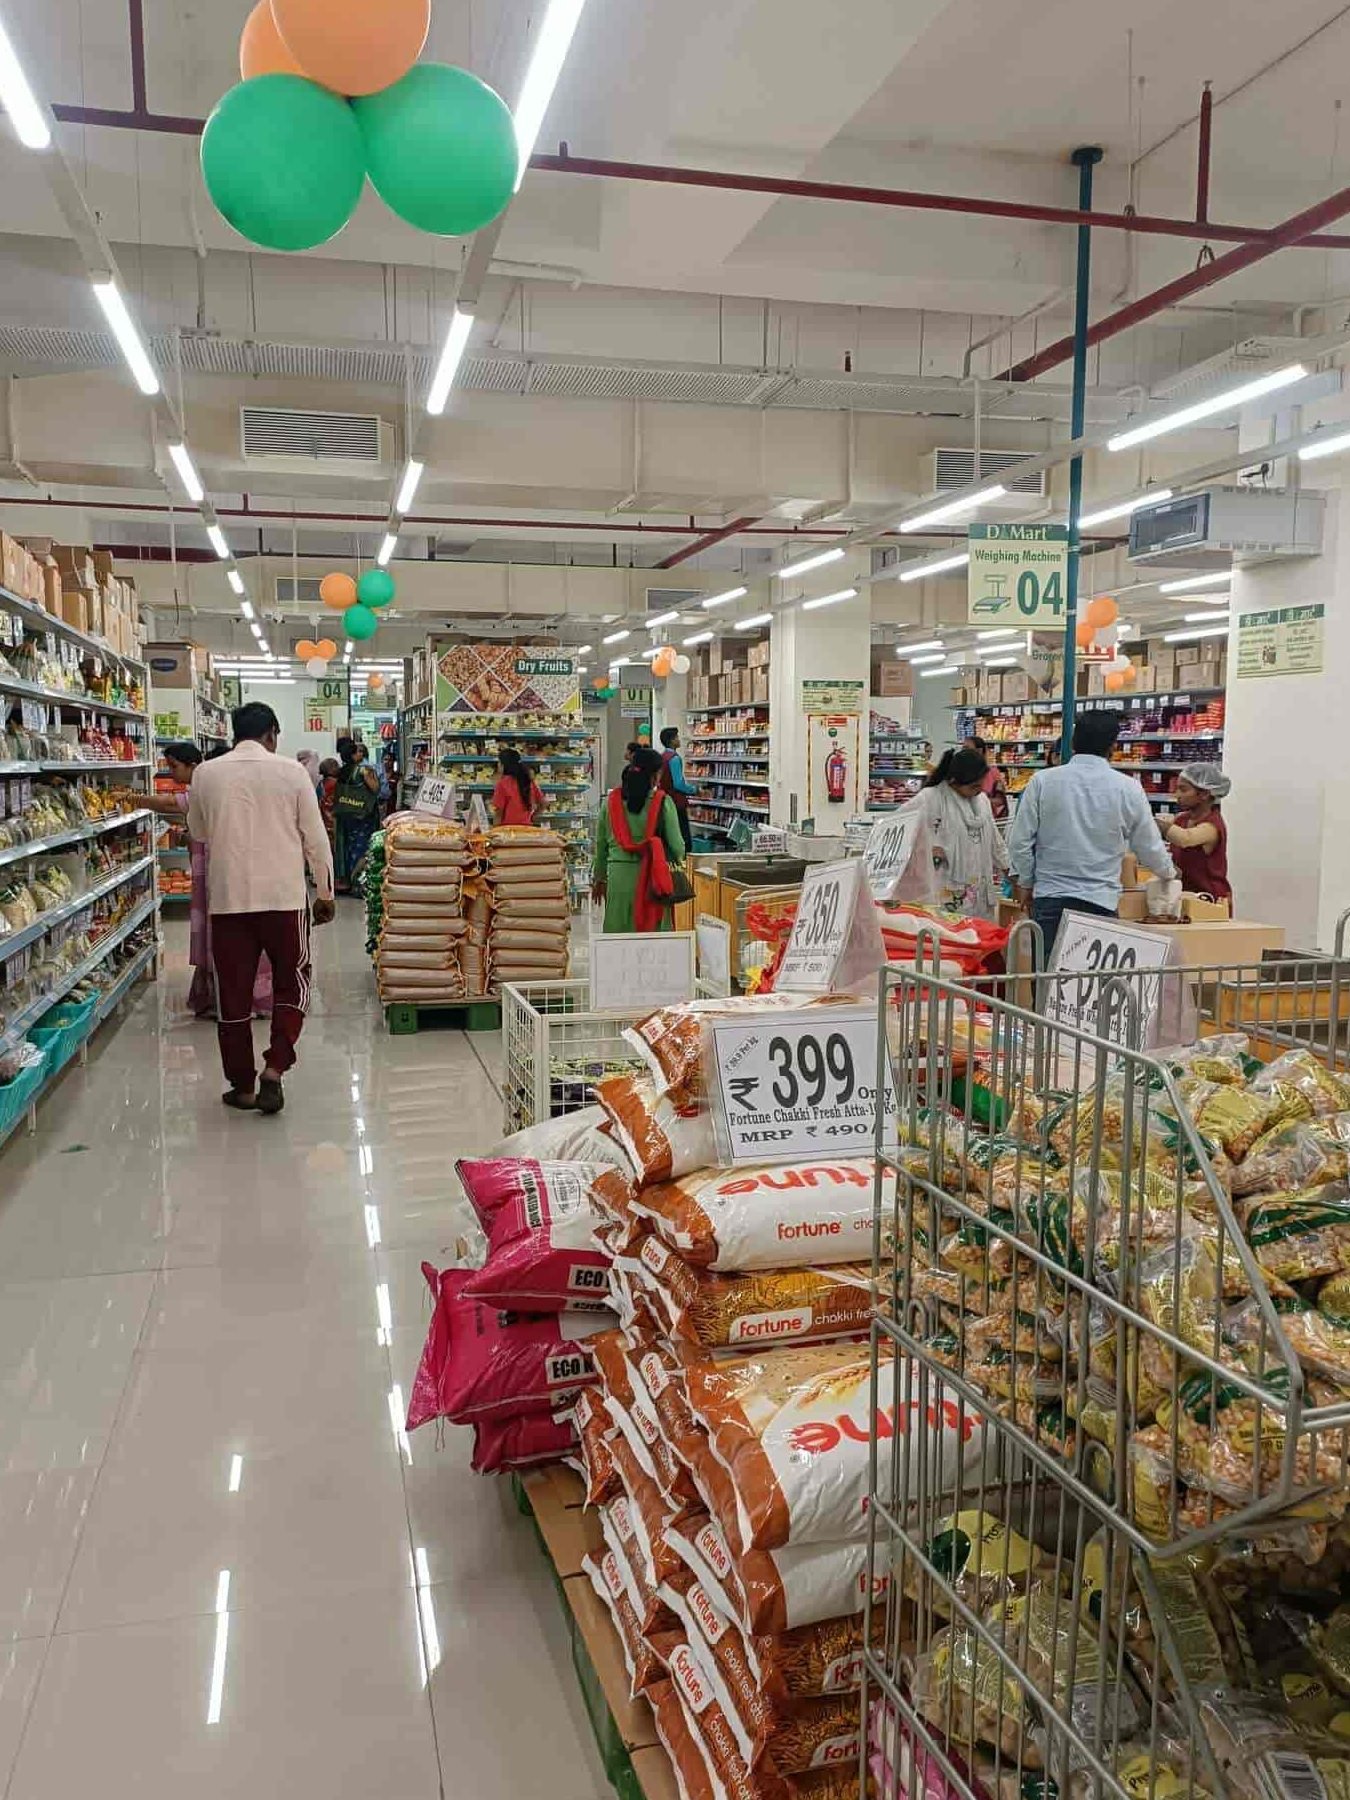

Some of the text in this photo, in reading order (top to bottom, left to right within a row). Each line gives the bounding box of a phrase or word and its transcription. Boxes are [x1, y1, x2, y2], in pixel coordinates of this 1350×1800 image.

[975, 550, 1061, 564] Weighing Machine
[1017, 570, 1064, 615] 04
[518, 661, 569, 673] Dry Fruits
[323, 682, 342, 698] 04
[769, 1033, 855, 1108] 399
[858, 1086, 892, 1101] Ony
[729, 1111, 771, 1126] Fortune
[773, 1107, 810, 1122] Chakki
[813, 1105, 839, 1120] Fresh
[845, 1103, 883, 1117] Atta-1
[740, 1129, 793, 1144] MRP
[778, 1220, 841, 1240] fortune
[574, 1268, 604, 1288] ECO
[740, 1316, 803, 1337] fortune
[814, 1309, 853, 1325] chakki
[552, 1357, 582, 1379] ECO
[700, 1530, 726, 1570] fortune
[693, 1588, 719, 1635] fortune
[677, 1650, 704, 1702] fortune
